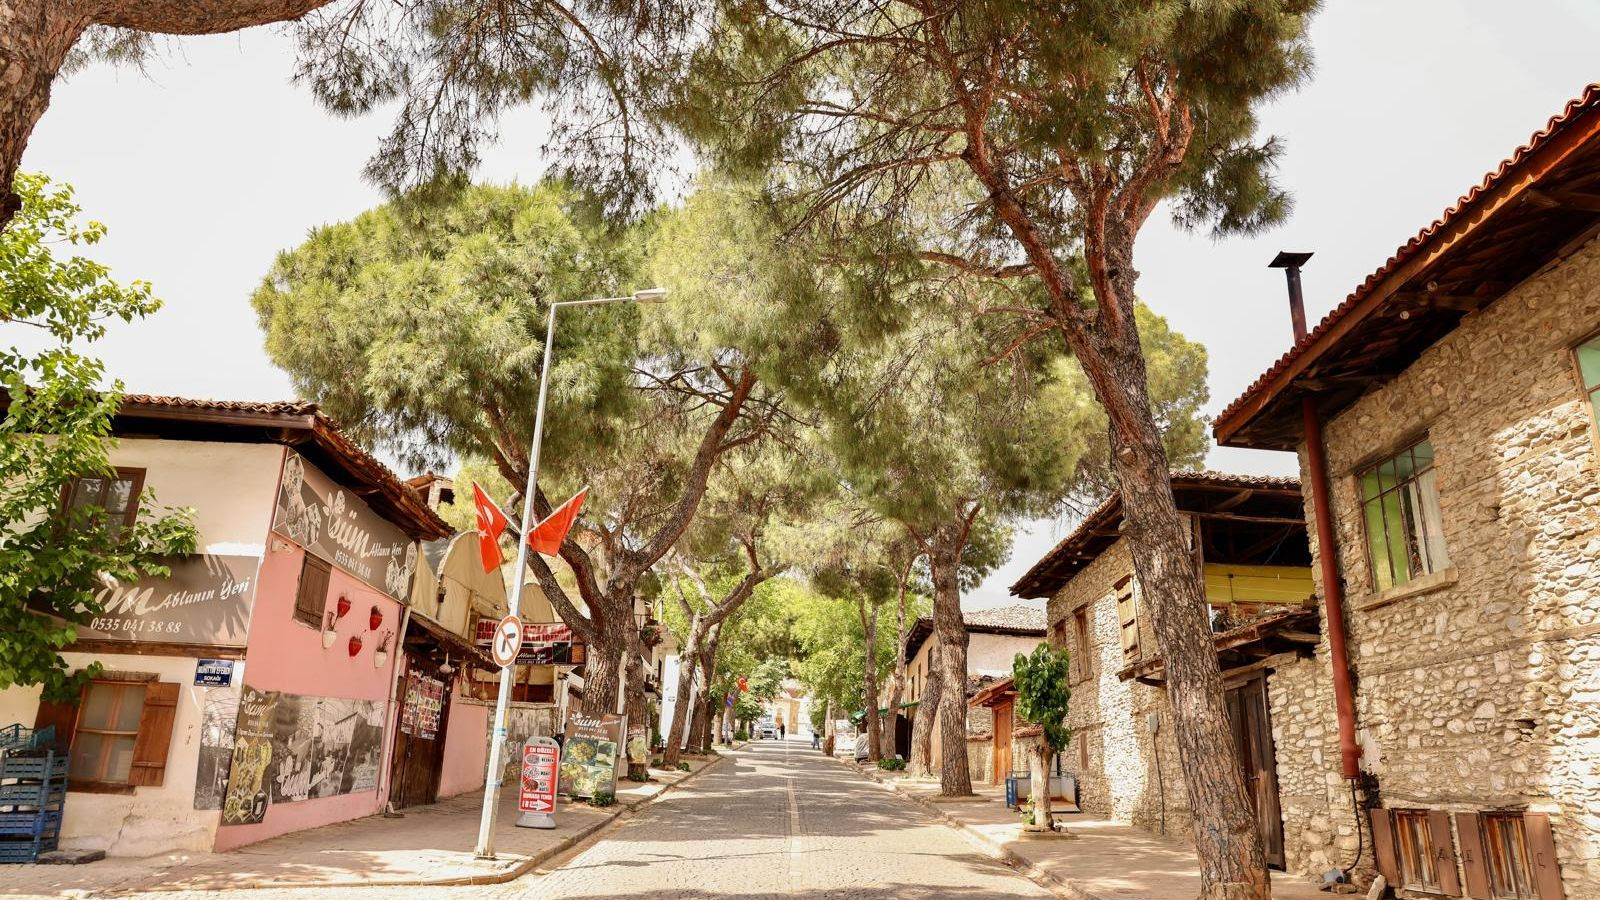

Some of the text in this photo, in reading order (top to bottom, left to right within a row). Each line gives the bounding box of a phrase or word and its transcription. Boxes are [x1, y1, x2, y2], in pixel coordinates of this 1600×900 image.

[159, 589, 215, 610] Ablanın
[219, 575, 251, 601] Yeri
[90, 617, 183, 633] 0535 041 38 88
